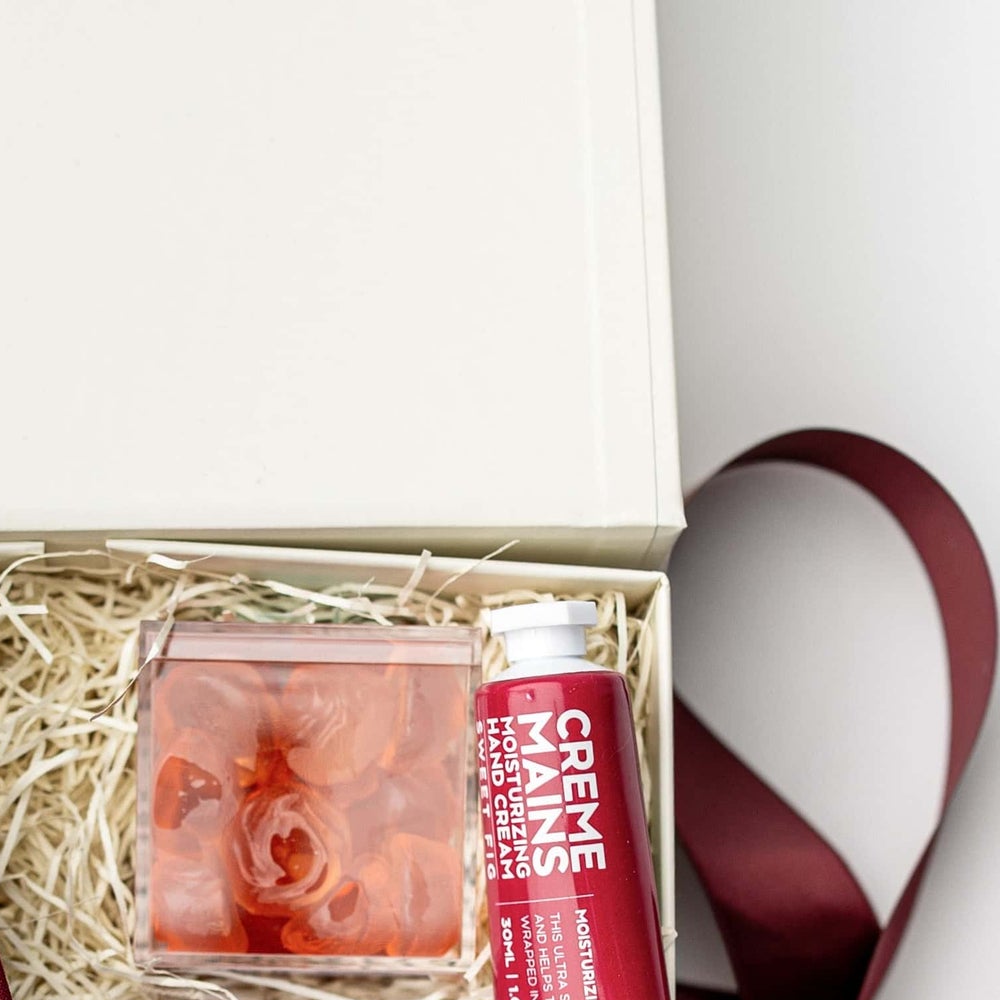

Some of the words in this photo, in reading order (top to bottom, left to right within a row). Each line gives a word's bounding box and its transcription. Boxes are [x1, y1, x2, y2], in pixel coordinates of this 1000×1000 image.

[486, 718, 505, 786] HAND
[476, 720, 490, 817] SWEET
[485, 834, 496, 880] FIG
[500, 716, 531, 879] MOISTURIZING
[517, 711, 569, 877] MAINS
[557, 709, 606, 872] CREME
[494, 793, 515, 879] CREAM
[501, 917, 515, 968] 30ML
[520, 915, 537, 986] WRAPPED
[534, 914, 547, 944] AND
[550, 912, 562, 942] THIS
[538, 948, 553, 992] HELPS
[553, 945, 568, 990] ULTRA
